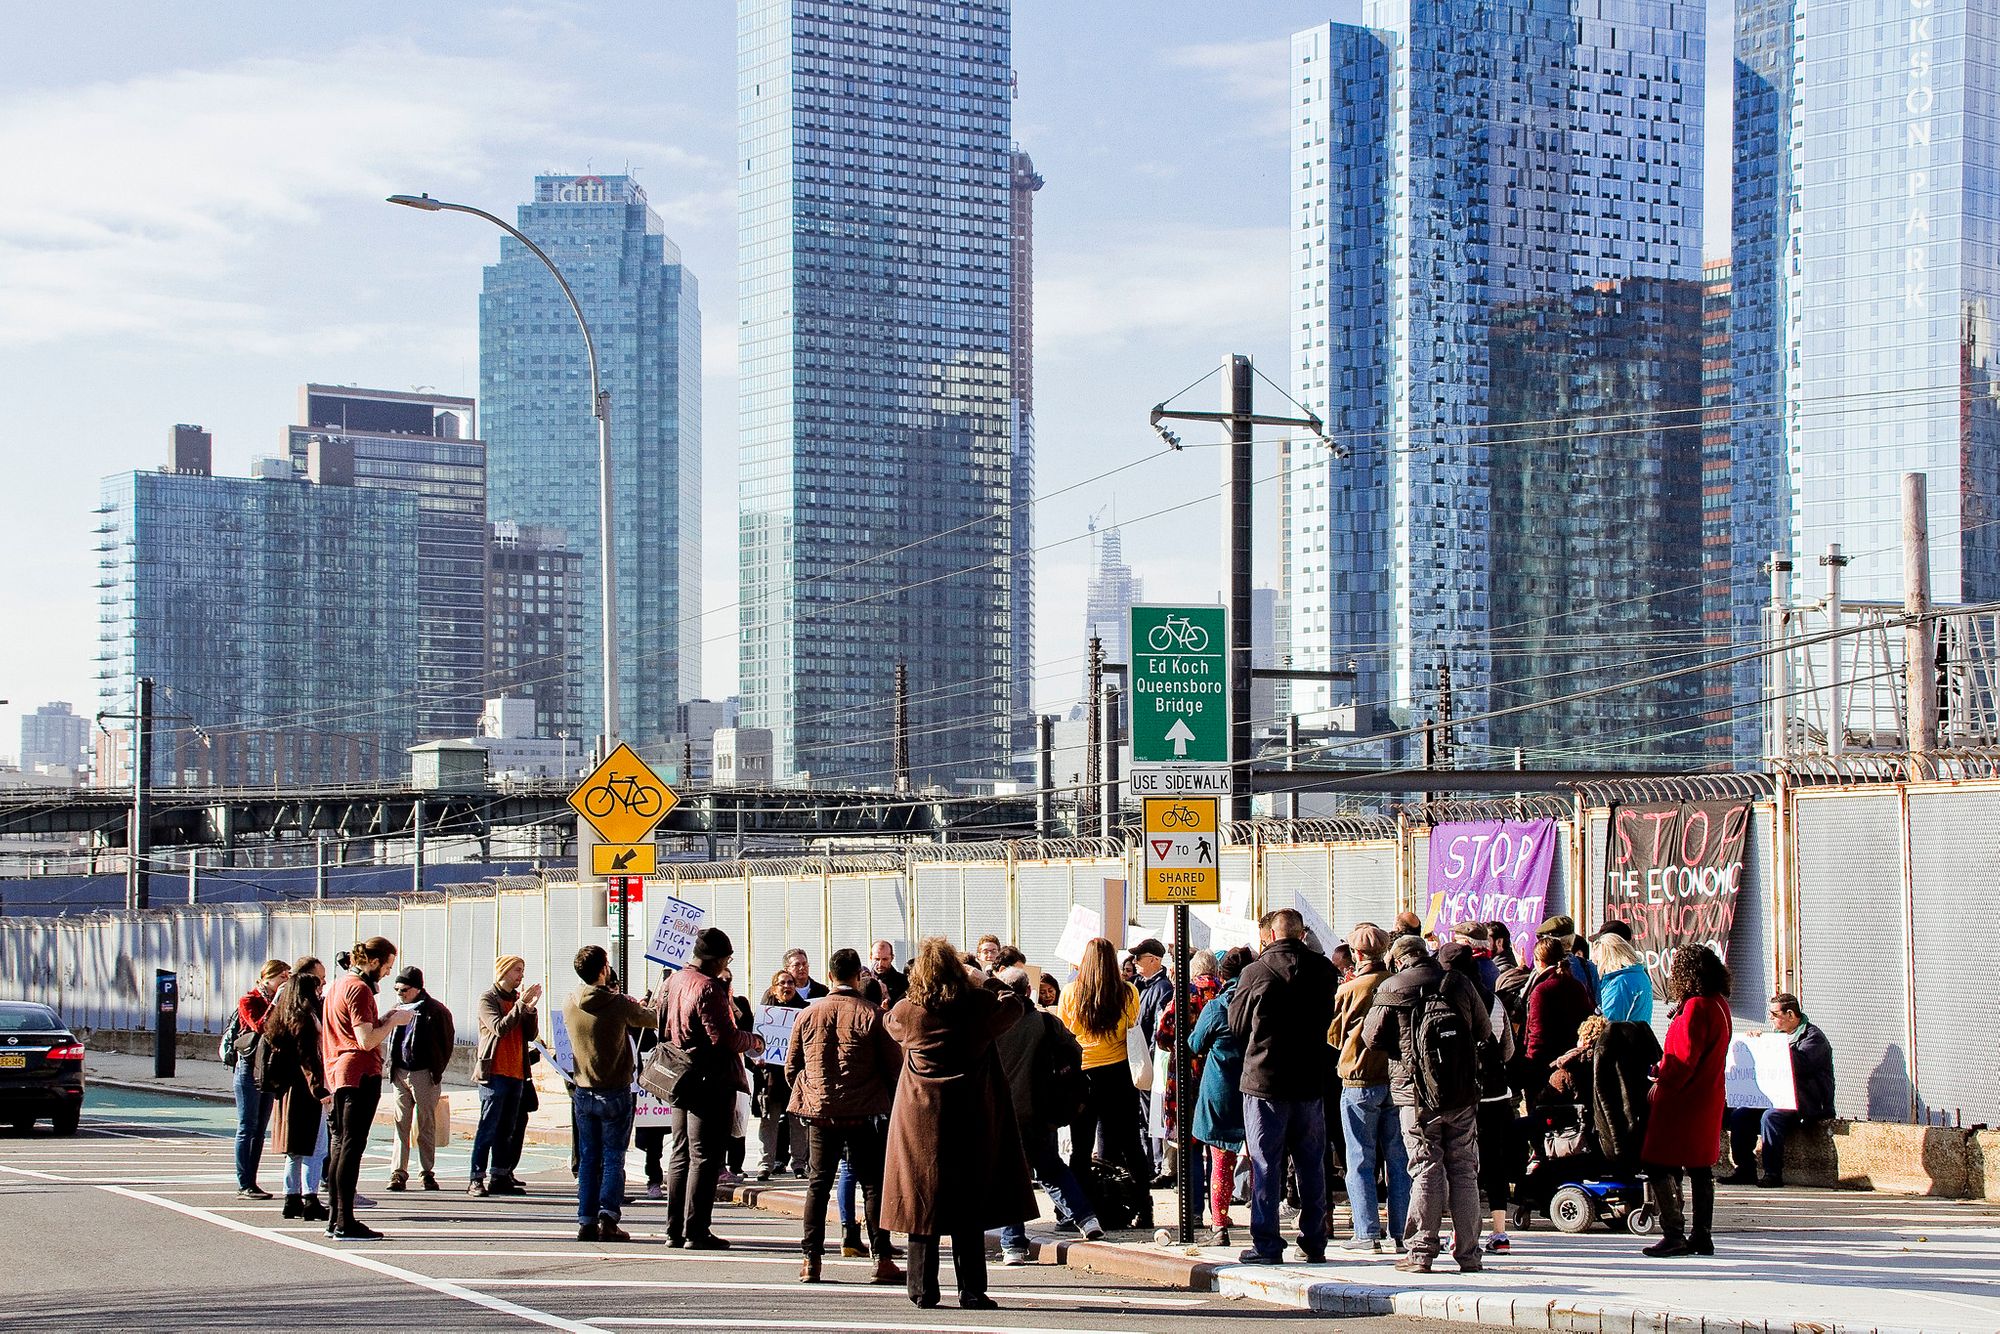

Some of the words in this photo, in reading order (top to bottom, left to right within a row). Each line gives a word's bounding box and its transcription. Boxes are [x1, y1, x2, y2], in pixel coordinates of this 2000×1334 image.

[1905, 0, 1933, 147] KSON
[559, 178, 604, 201] citi
[1904, 172, 1929, 308] PARK
[1149, 659, 1167, 674] Ed
[1172, 659, 1209, 674] Koch
[1136, 677, 1222, 693] Queensboro
[1155, 697, 1203, 717] Bridge
[1133, 774, 1158, 790] USE
[1165, 774, 1229, 790] SIDEWALK
[1615, 804, 1749, 867] STOP
[1175, 845, 1190, 856] TO
[1443, 832, 1535, 881] STOP
[1159, 872, 1206, 883] SHARED
[1608, 869, 1640, 898] THE
[1167, 886, 1197, 897] ZONE
[671, 903, 701, 921] STOP
[655, 939, 685, 959] TION
[765, 1007, 799, 1026] ST
